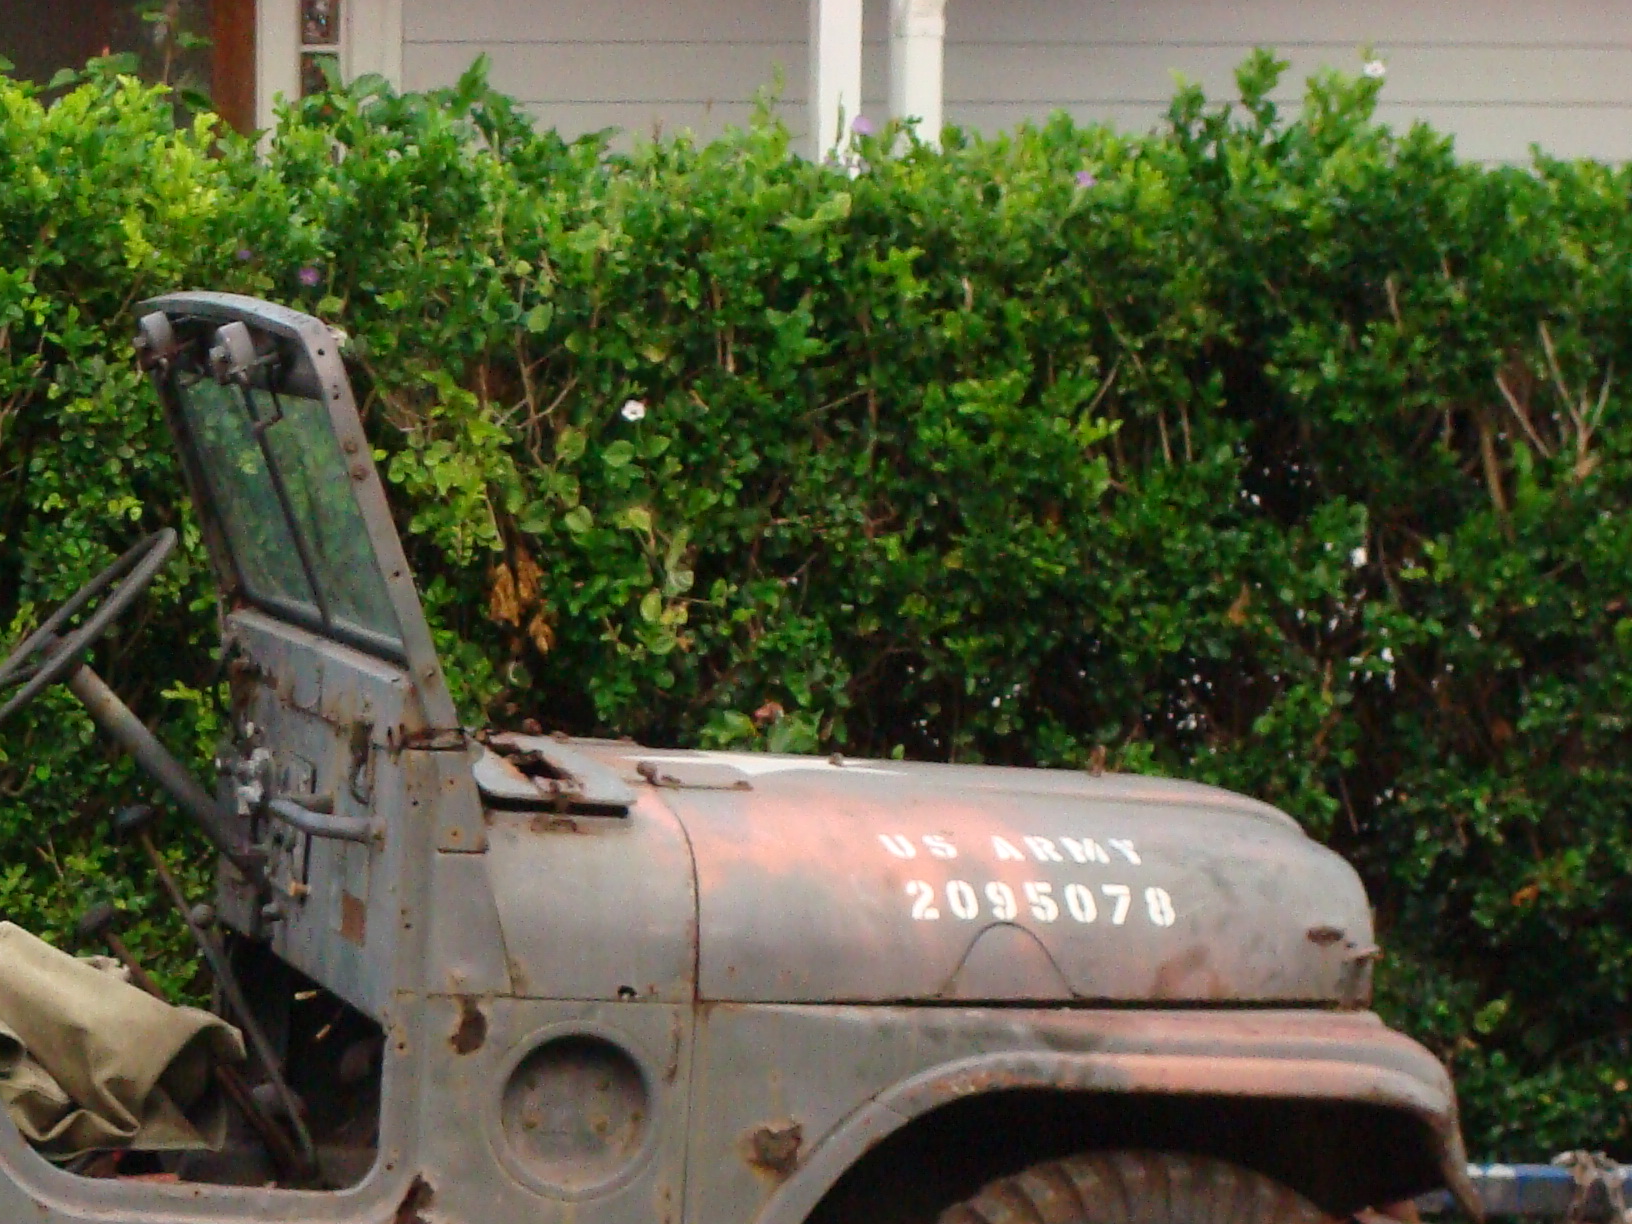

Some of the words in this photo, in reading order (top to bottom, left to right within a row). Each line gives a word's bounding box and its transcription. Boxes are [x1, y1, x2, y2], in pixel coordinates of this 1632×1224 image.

[878, 834, 958, 860] US
[991, 835, 1142, 865] ARMY
[905, 879, 1176, 928] 2095078
